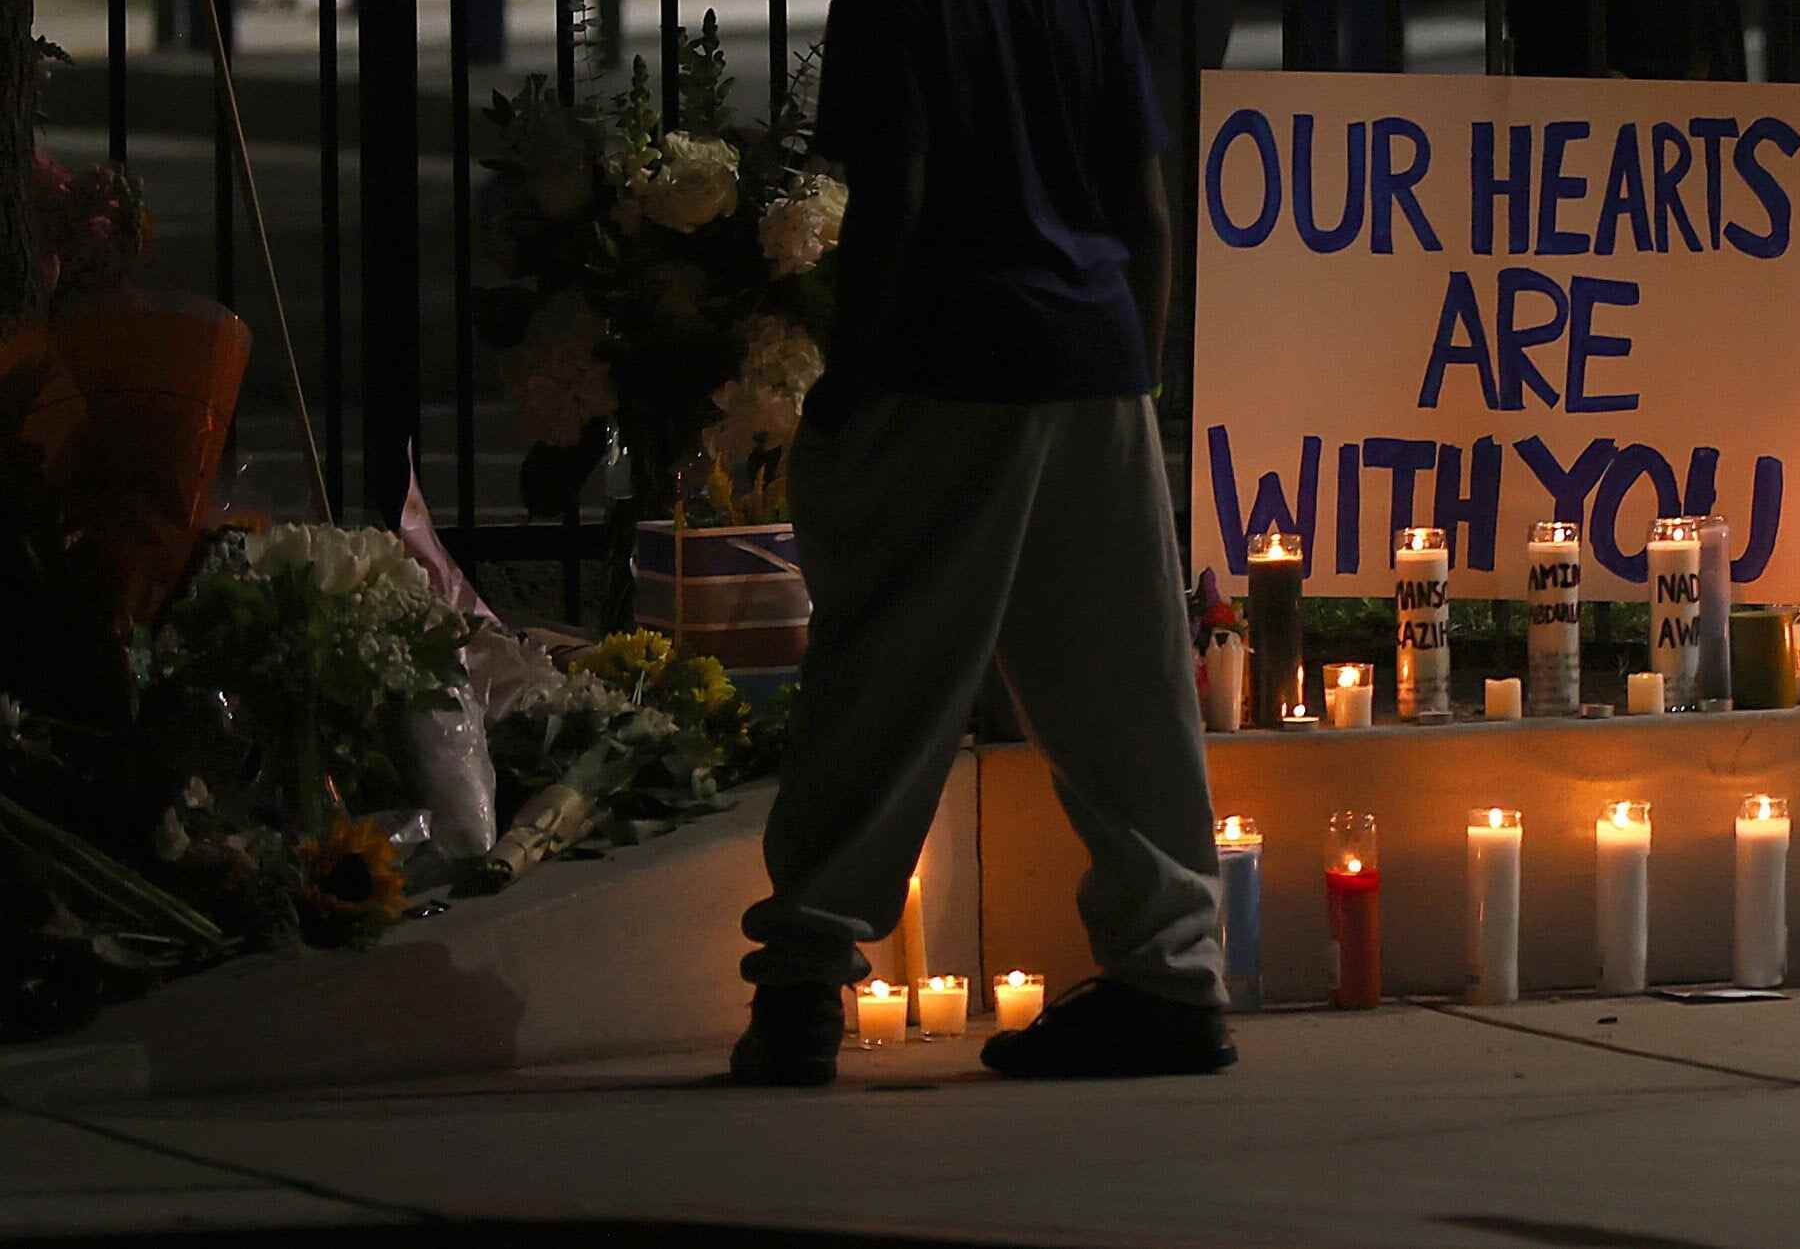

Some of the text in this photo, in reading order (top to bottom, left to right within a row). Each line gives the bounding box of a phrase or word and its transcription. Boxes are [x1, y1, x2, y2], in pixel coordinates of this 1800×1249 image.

[1205, 109, 1443, 255] OUR
[1418, 268, 1639, 412] ARE
[1207, 424, 1784, 583] WITH YOU
